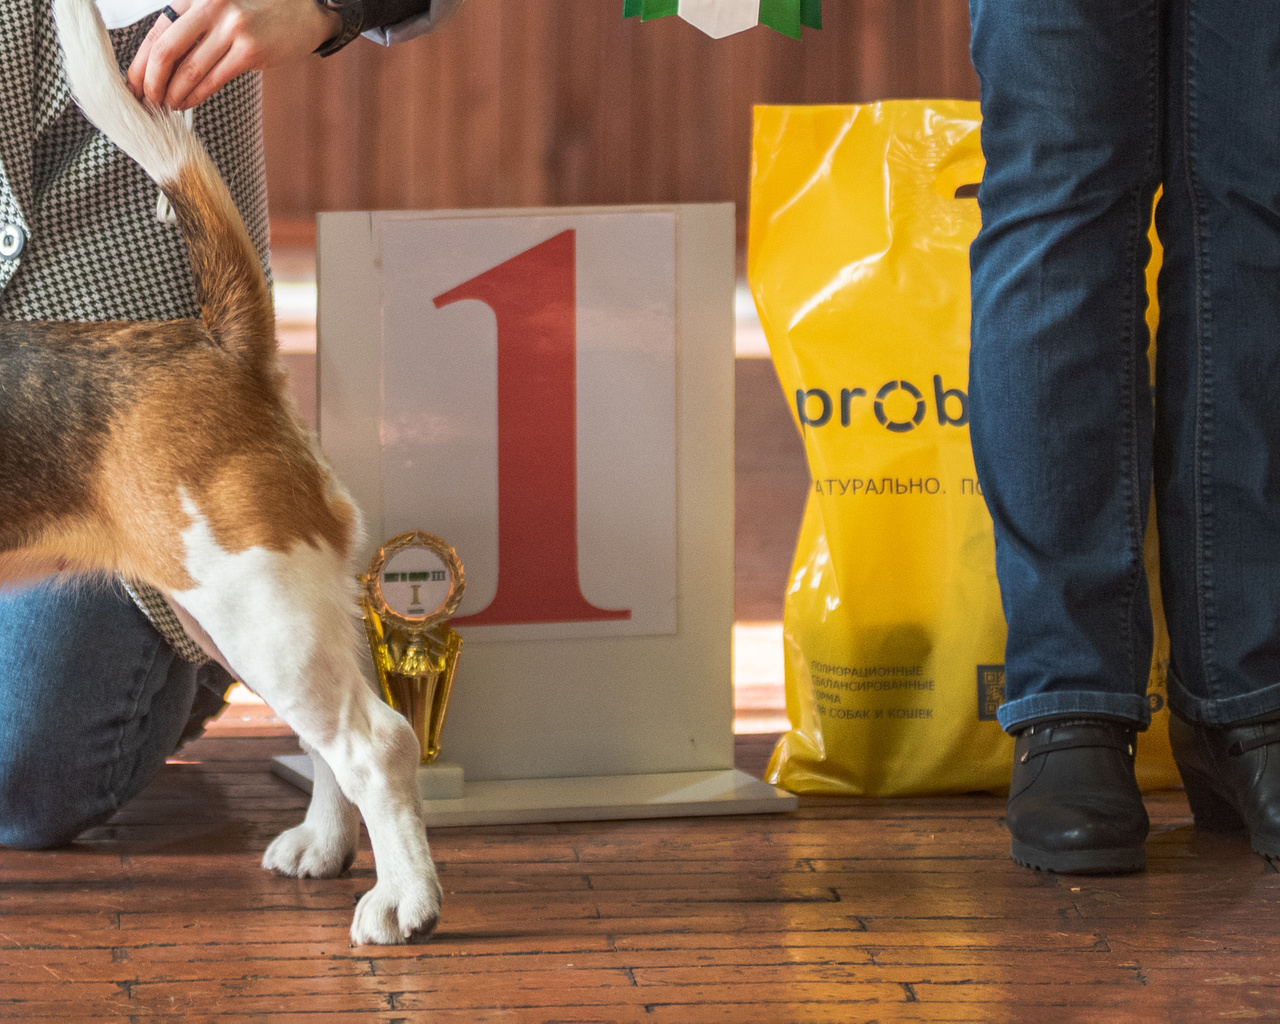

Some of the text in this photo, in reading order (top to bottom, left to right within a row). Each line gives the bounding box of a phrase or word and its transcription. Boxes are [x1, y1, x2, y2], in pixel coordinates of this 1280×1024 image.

[796, 374, 969, 439] prob
[432, 229, 632, 627] 1
[815, 477, 947, 495] АТУРАЛЬНО.
[811, 660, 923, 678] ПОЛНОРАЦИОННЫЕ
[813, 689, 841, 704] ОРМА
[829, 708, 871, 719] СОБАК
[875, 709, 884, 718] И
[888, 708, 934, 719] КОШЕК
